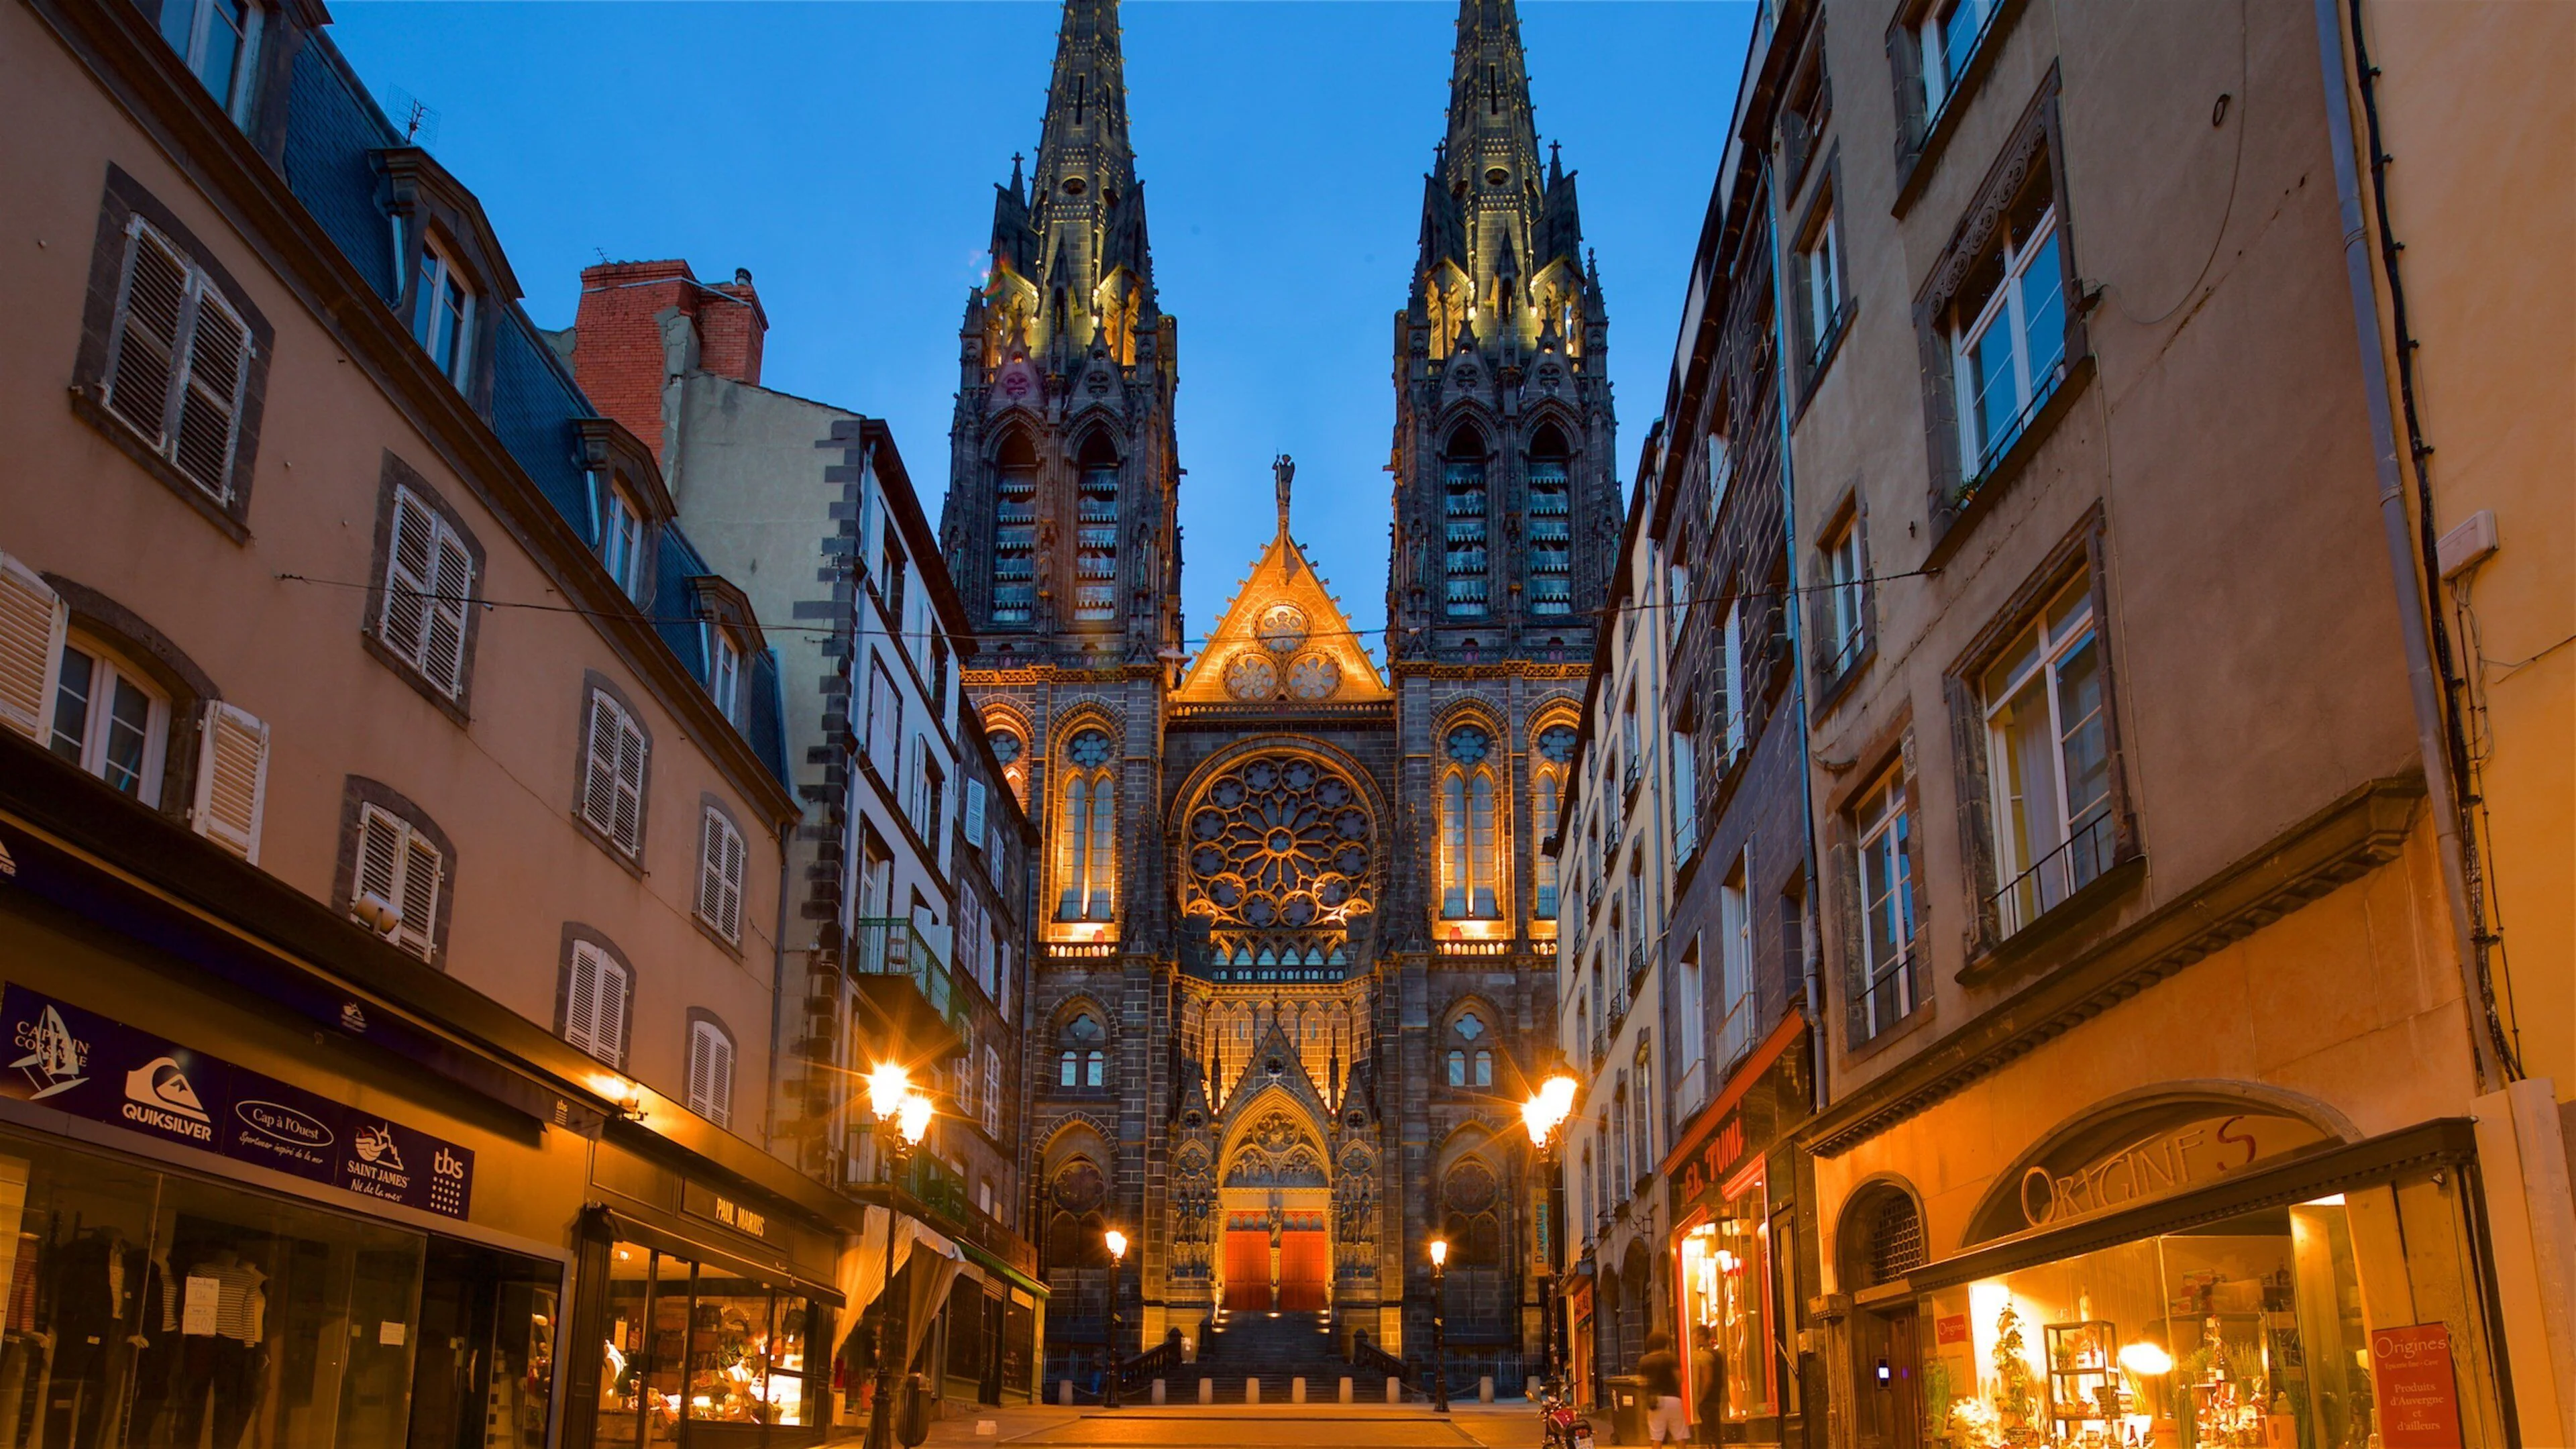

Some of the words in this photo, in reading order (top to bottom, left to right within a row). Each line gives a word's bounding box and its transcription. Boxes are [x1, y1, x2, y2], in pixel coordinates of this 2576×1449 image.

[17, 1021, 89, 1055] CAPTAIN
[121, 1103, 211, 1142] QUIKSILVER
[252, 1108, 275, 1128] Cap
[276, 1115, 283, 1129] à
[285, 1116, 319, 1140] l'Ouest
[346, 1159, 379, 1180] SAINT
[376, 1169, 408, 1189] JAMES
[433, 1147, 464, 1180] tbs
[363, 1181, 375, 1195] de
[374, 1183, 385, 1197] la
[1685, 1161, 1705, 1204] EL
[715, 1197, 735, 1226] PAUL
[2374, 1336, 2447, 1359] Origines
[2390, 1395, 2445, 1407] d'Auvergne
[2394, 1382, 2436, 1393] Produits
[2396, 1420, 2441, 1432] d'ailleurs
[2412, 1409, 2423, 1417] et
